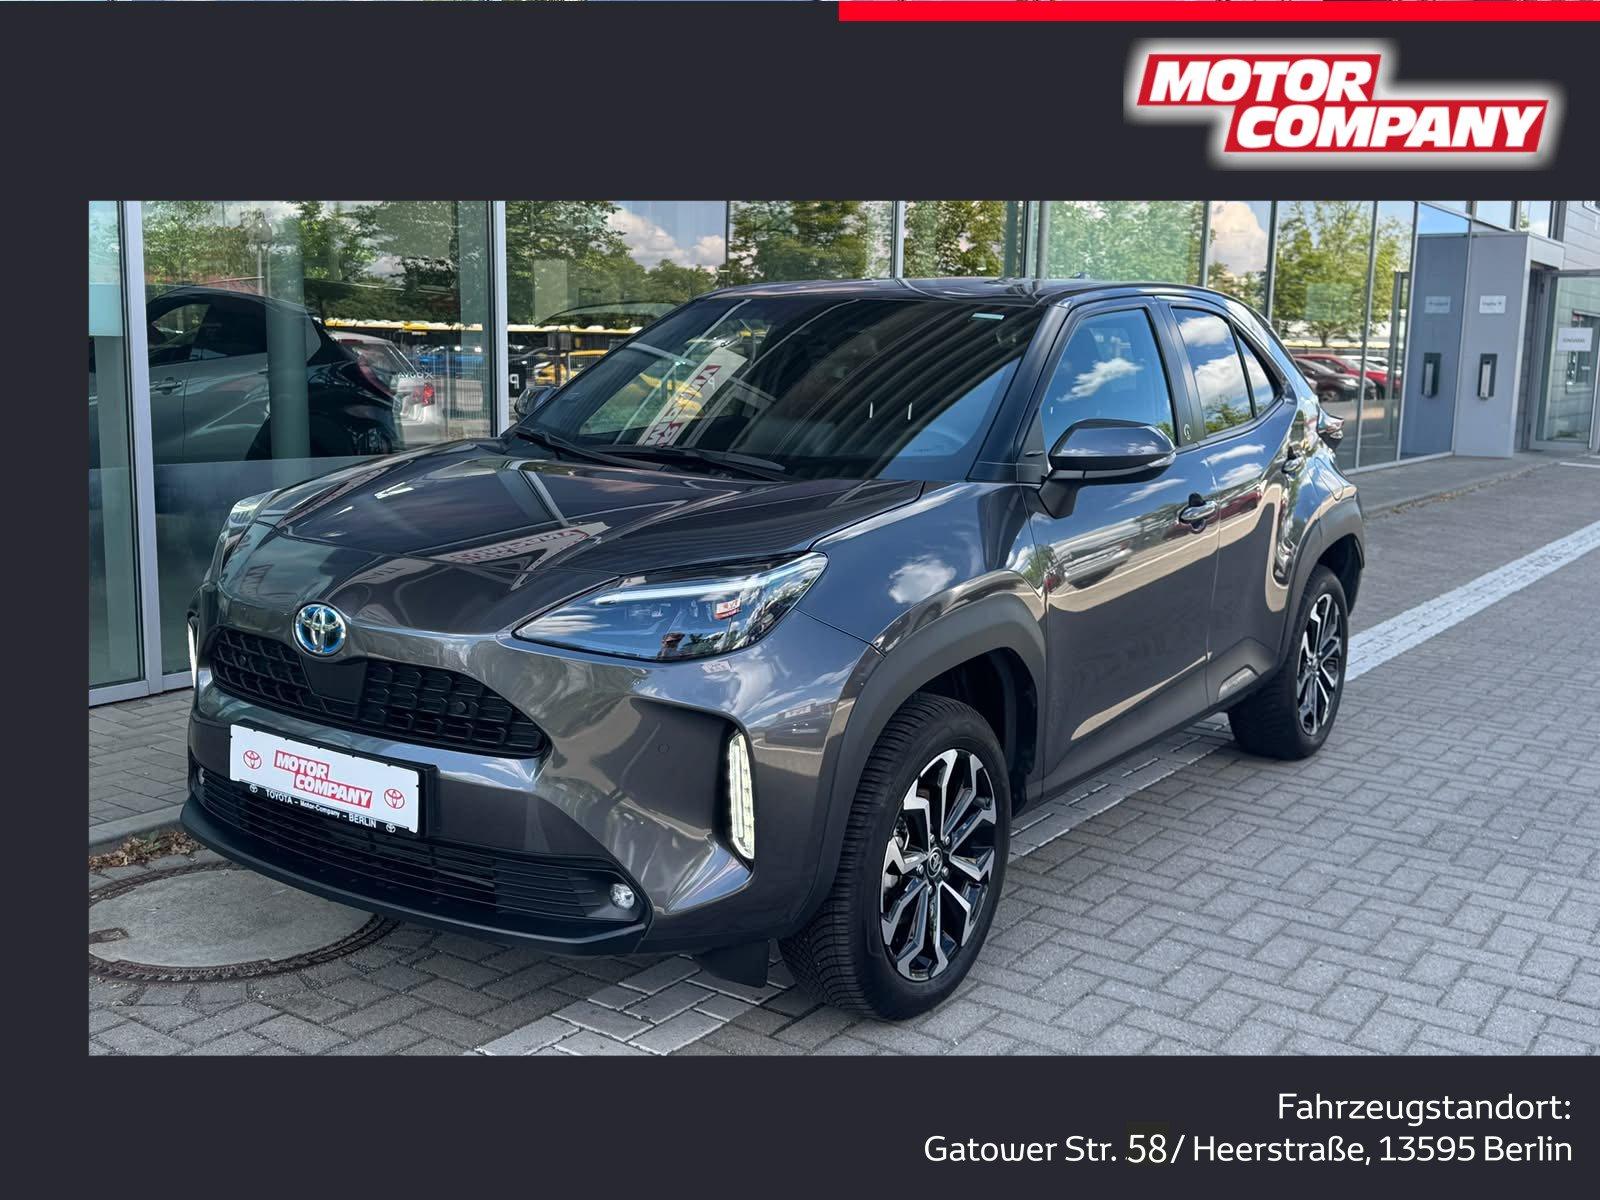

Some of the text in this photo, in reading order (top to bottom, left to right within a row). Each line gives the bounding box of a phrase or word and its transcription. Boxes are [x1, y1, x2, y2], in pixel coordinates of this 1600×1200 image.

[277, 753, 328, 779] MOTOR
[295, 774, 372, 806] COMPANY
[265, 789, 293, 805] TOYOTA
[300, 800, 341, 819] Motor-Company
[348, 812, 377, 829] BERLIN
